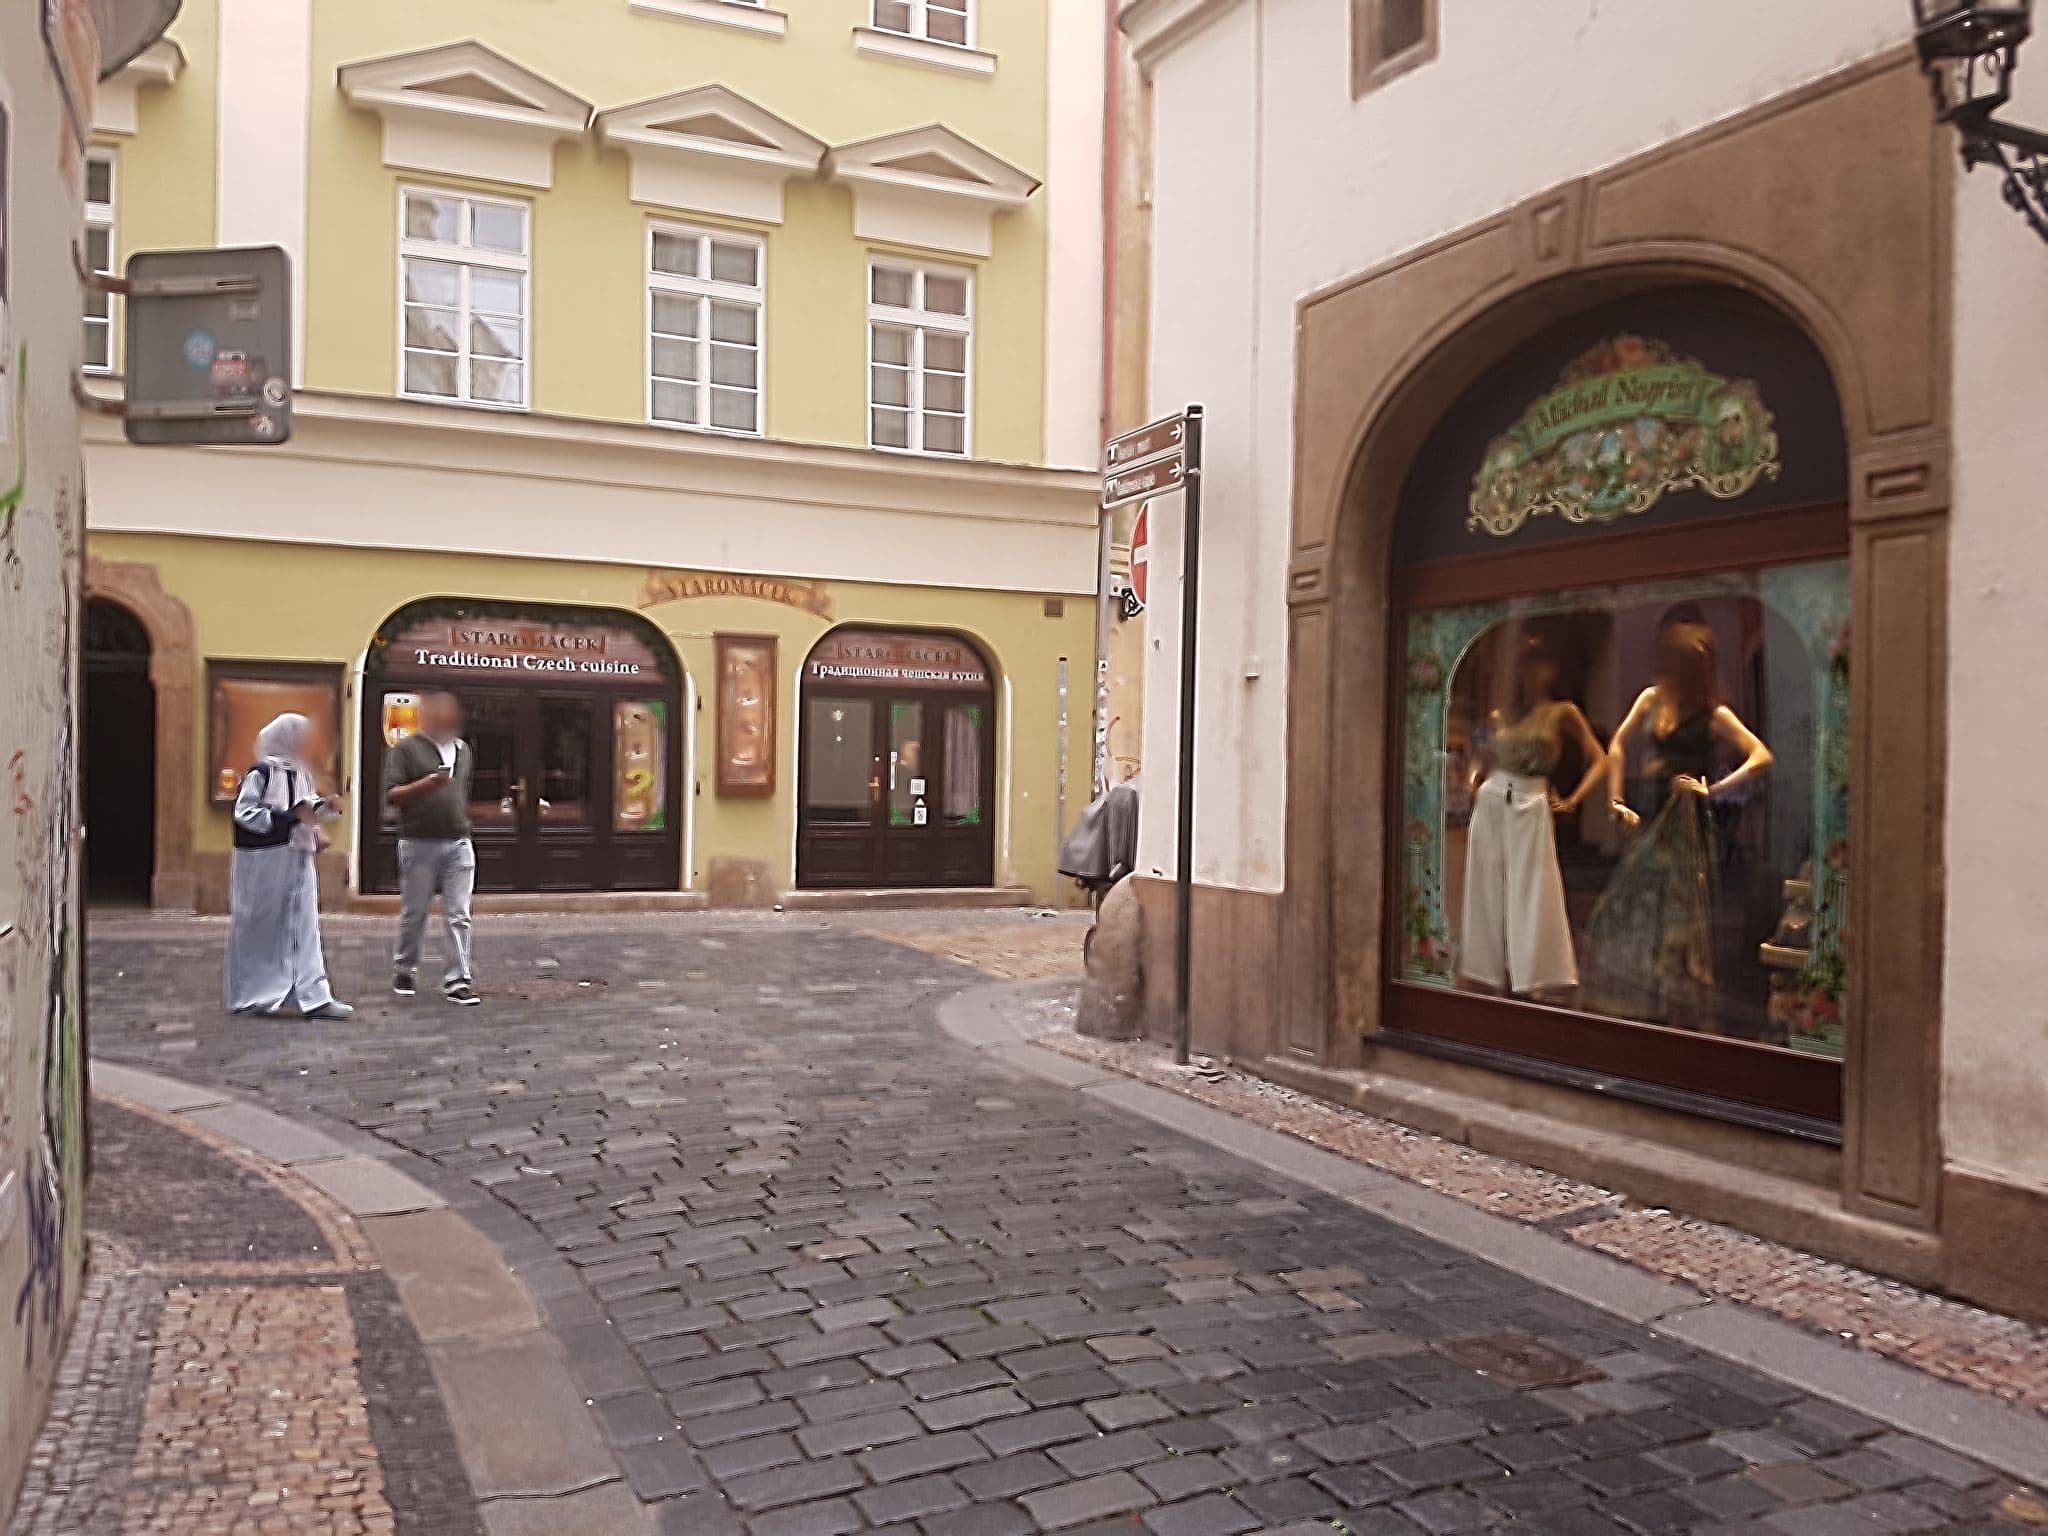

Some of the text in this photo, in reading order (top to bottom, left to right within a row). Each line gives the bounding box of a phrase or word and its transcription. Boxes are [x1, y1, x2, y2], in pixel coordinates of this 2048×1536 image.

[415, 649, 641, 675] Traditional Czech cuisine
[811, 660, 899, 678] Традиционная
[901, 668, 949, 680] чешская
